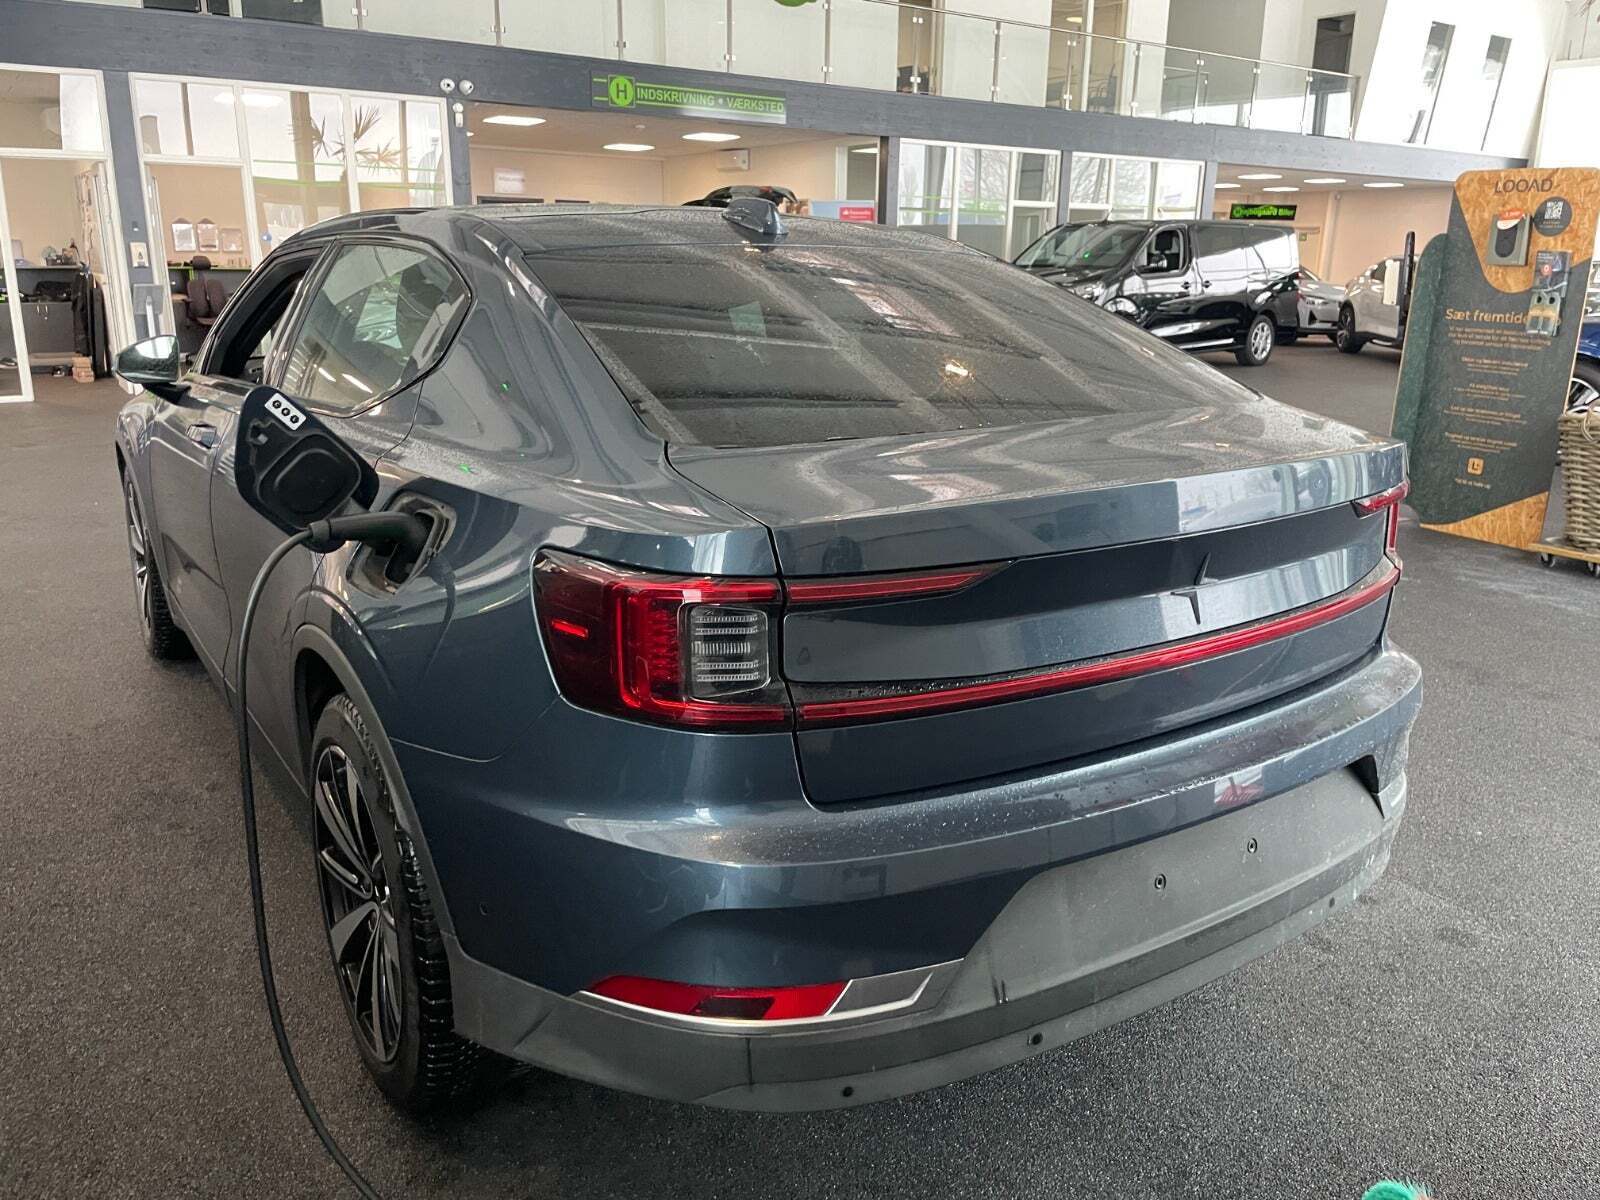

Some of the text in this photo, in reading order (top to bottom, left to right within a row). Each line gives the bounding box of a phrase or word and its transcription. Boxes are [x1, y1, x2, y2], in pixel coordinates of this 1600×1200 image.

[637, 87, 715, 107] INDSKRIVNING
[726, 97, 785, 114] VÆRKSTED
[1495, 179, 1553, 193] LOOAD
[1444, 308, 1470, 321] Sæt
